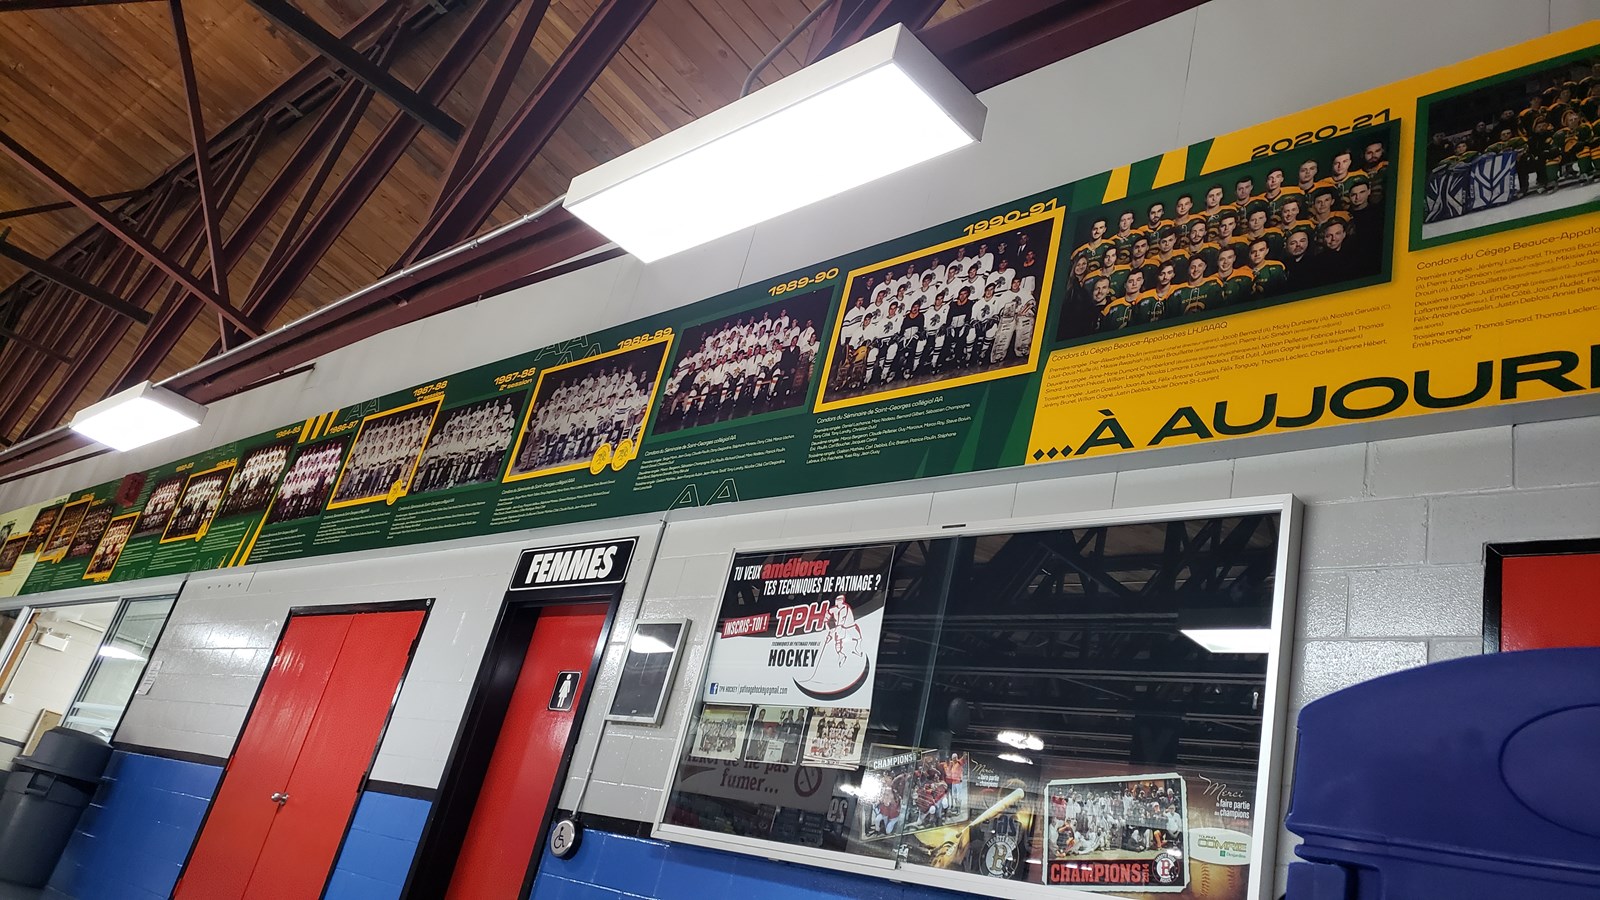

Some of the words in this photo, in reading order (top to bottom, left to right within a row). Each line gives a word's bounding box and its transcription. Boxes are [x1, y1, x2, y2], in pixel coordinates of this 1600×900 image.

[1250, 108, 1391, 160] 2020-21
[963, 197, 1058, 236] 1990-91
[1416, 257, 1459, 270] Condors
[1460, 253, 1474, 261] du
[1475, 246, 1511, 257] Cégep
[1571, 258, 1599, 267] Jacob
[768, 267, 839, 297] 1989-90
[1478, 287, 1502, 296] Justin
[1552, 290, 1576, 298] Annie
[1358, 323, 1385, 331] Thomas
[1474, 321, 1504, 330] Thomas
[1535, 311, 1568, 319] Thomas
[617, 327, 673, 349] 1988-89
[1432, 335, 1473, 345] Provencher
[1051, 352, 1080, 362] Condors
[1080, 349, 1089, 357] du
[493, 367, 537, 386] 1987-88
[525, 545, 618, 584] FEMMES
[733, 566, 743, 581] TU
[744, 563, 762, 580] VEUX
[761, 558, 830, 579] améliorer
[763, 580, 778, 596] TES
[777, 576, 823, 596] TECHNIQUES
[823, 576, 833, 592] DE
[833, 574, 872, 592] PATINAGE
[776, 600, 830, 637] TPH
[768, 649, 819, 667] HOCKEY
[873, 753, 913, 770] CHAMPIONS
[1199, 773, 1244, 802] Merci
[1219, 808, 1250, 820] champions
[1220, 799, 1233, 809] faire
[1234, 801, 1250, 810] partie
[1051, 862, 1142, 884] CHAMPIONS
